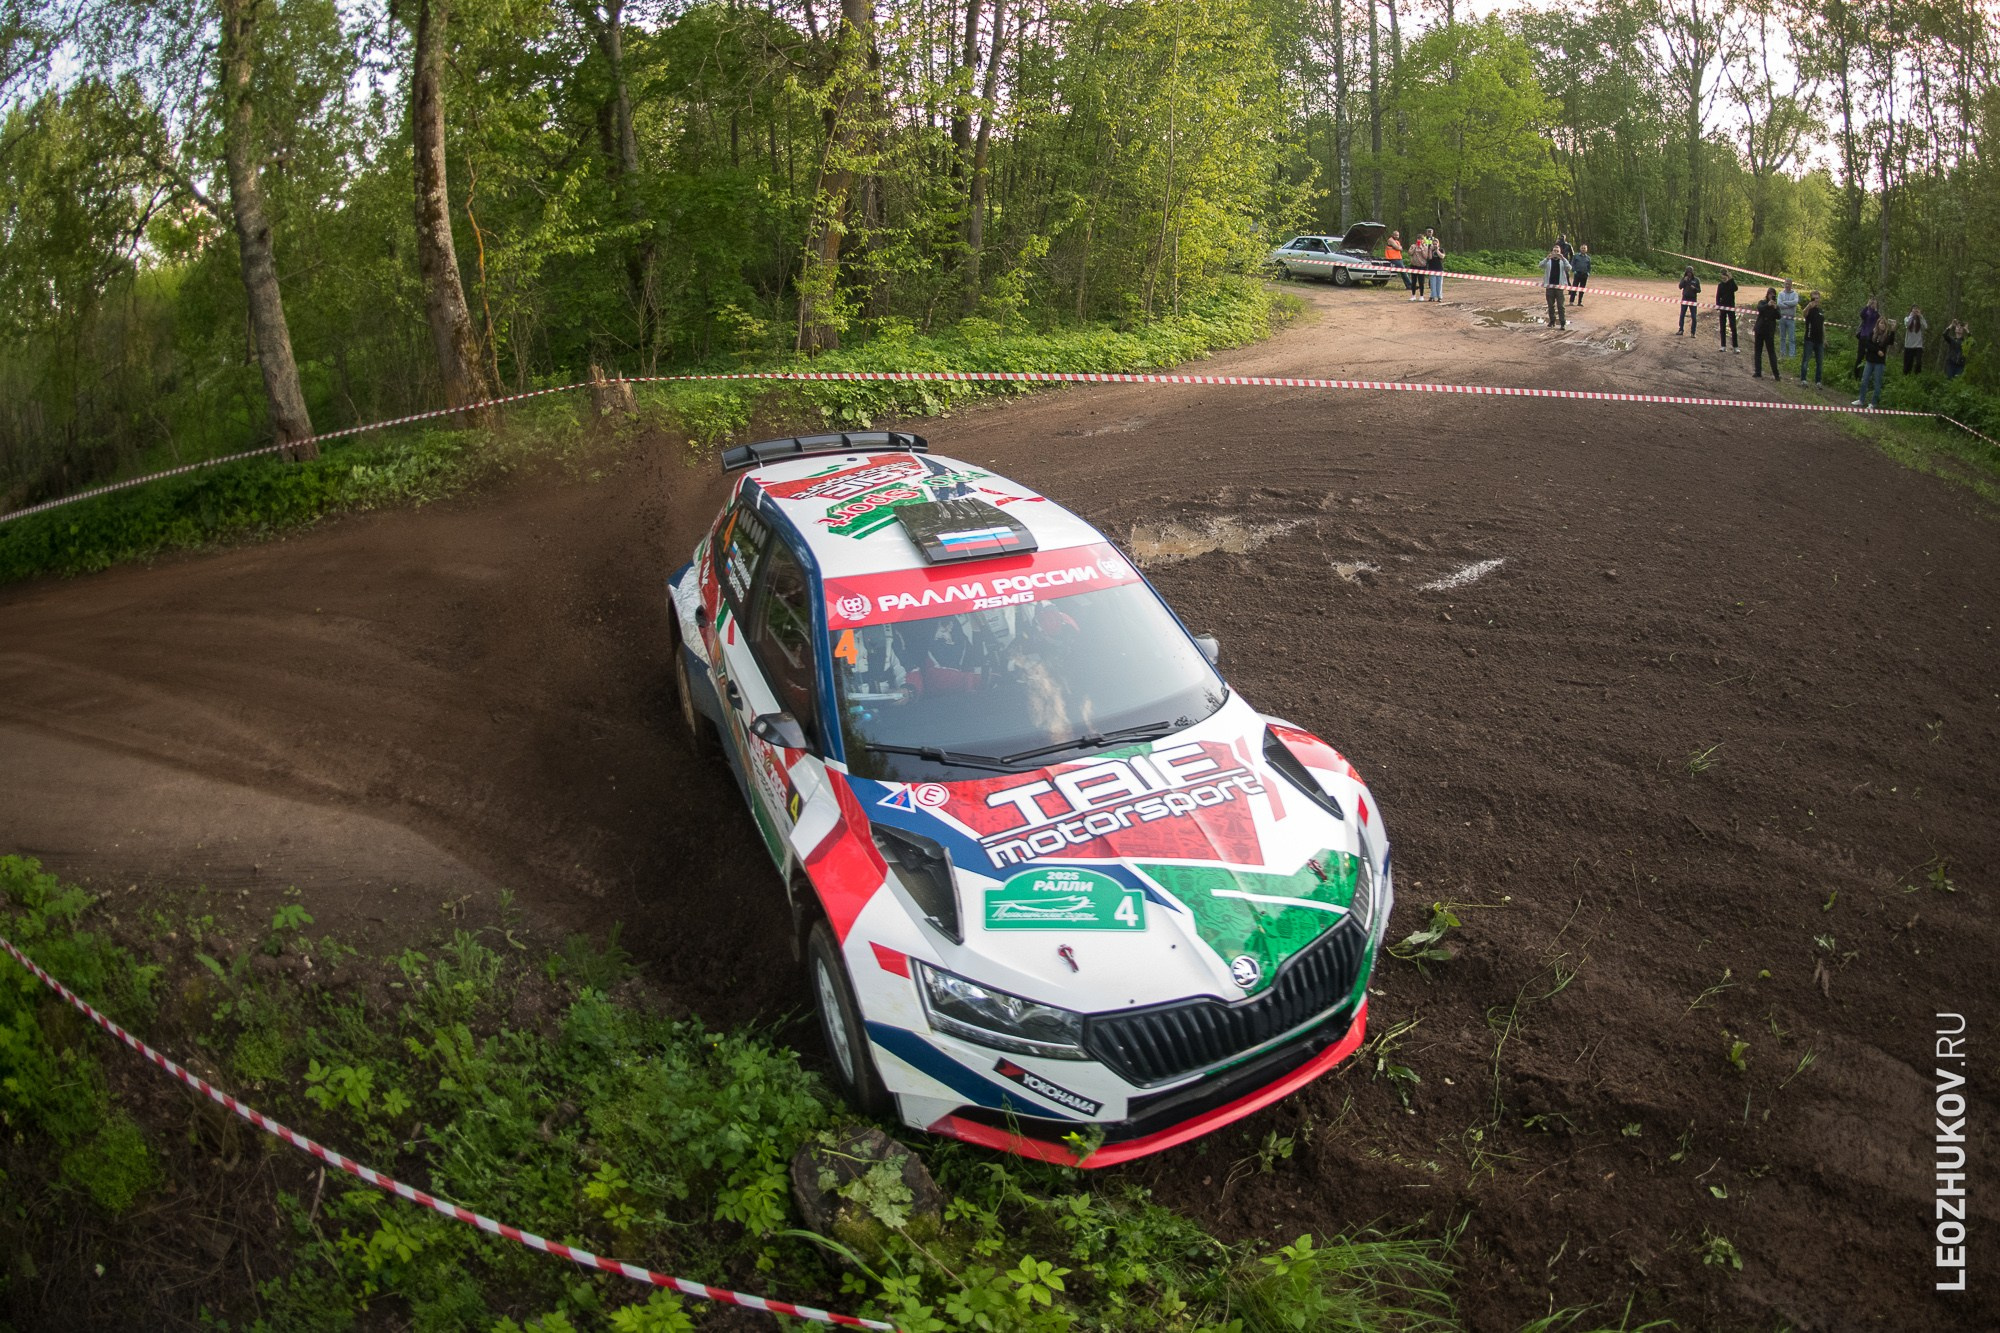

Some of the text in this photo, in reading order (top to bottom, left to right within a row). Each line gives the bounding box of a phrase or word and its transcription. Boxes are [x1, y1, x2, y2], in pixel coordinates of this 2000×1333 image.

[876, 565, 1099, 613] РАЛЛИ РОССИИ
[834, 629, 858, 665] 4
[982, 774, 1268, 870] motorsport
[1033, 880, 1094, 892] РАЛЛИ
[1046, 871, 1080, 881] 2025
[1113, 895, 1139, 927] 4
[1022, 1072, 1096, 1114] YOKOHAMA
